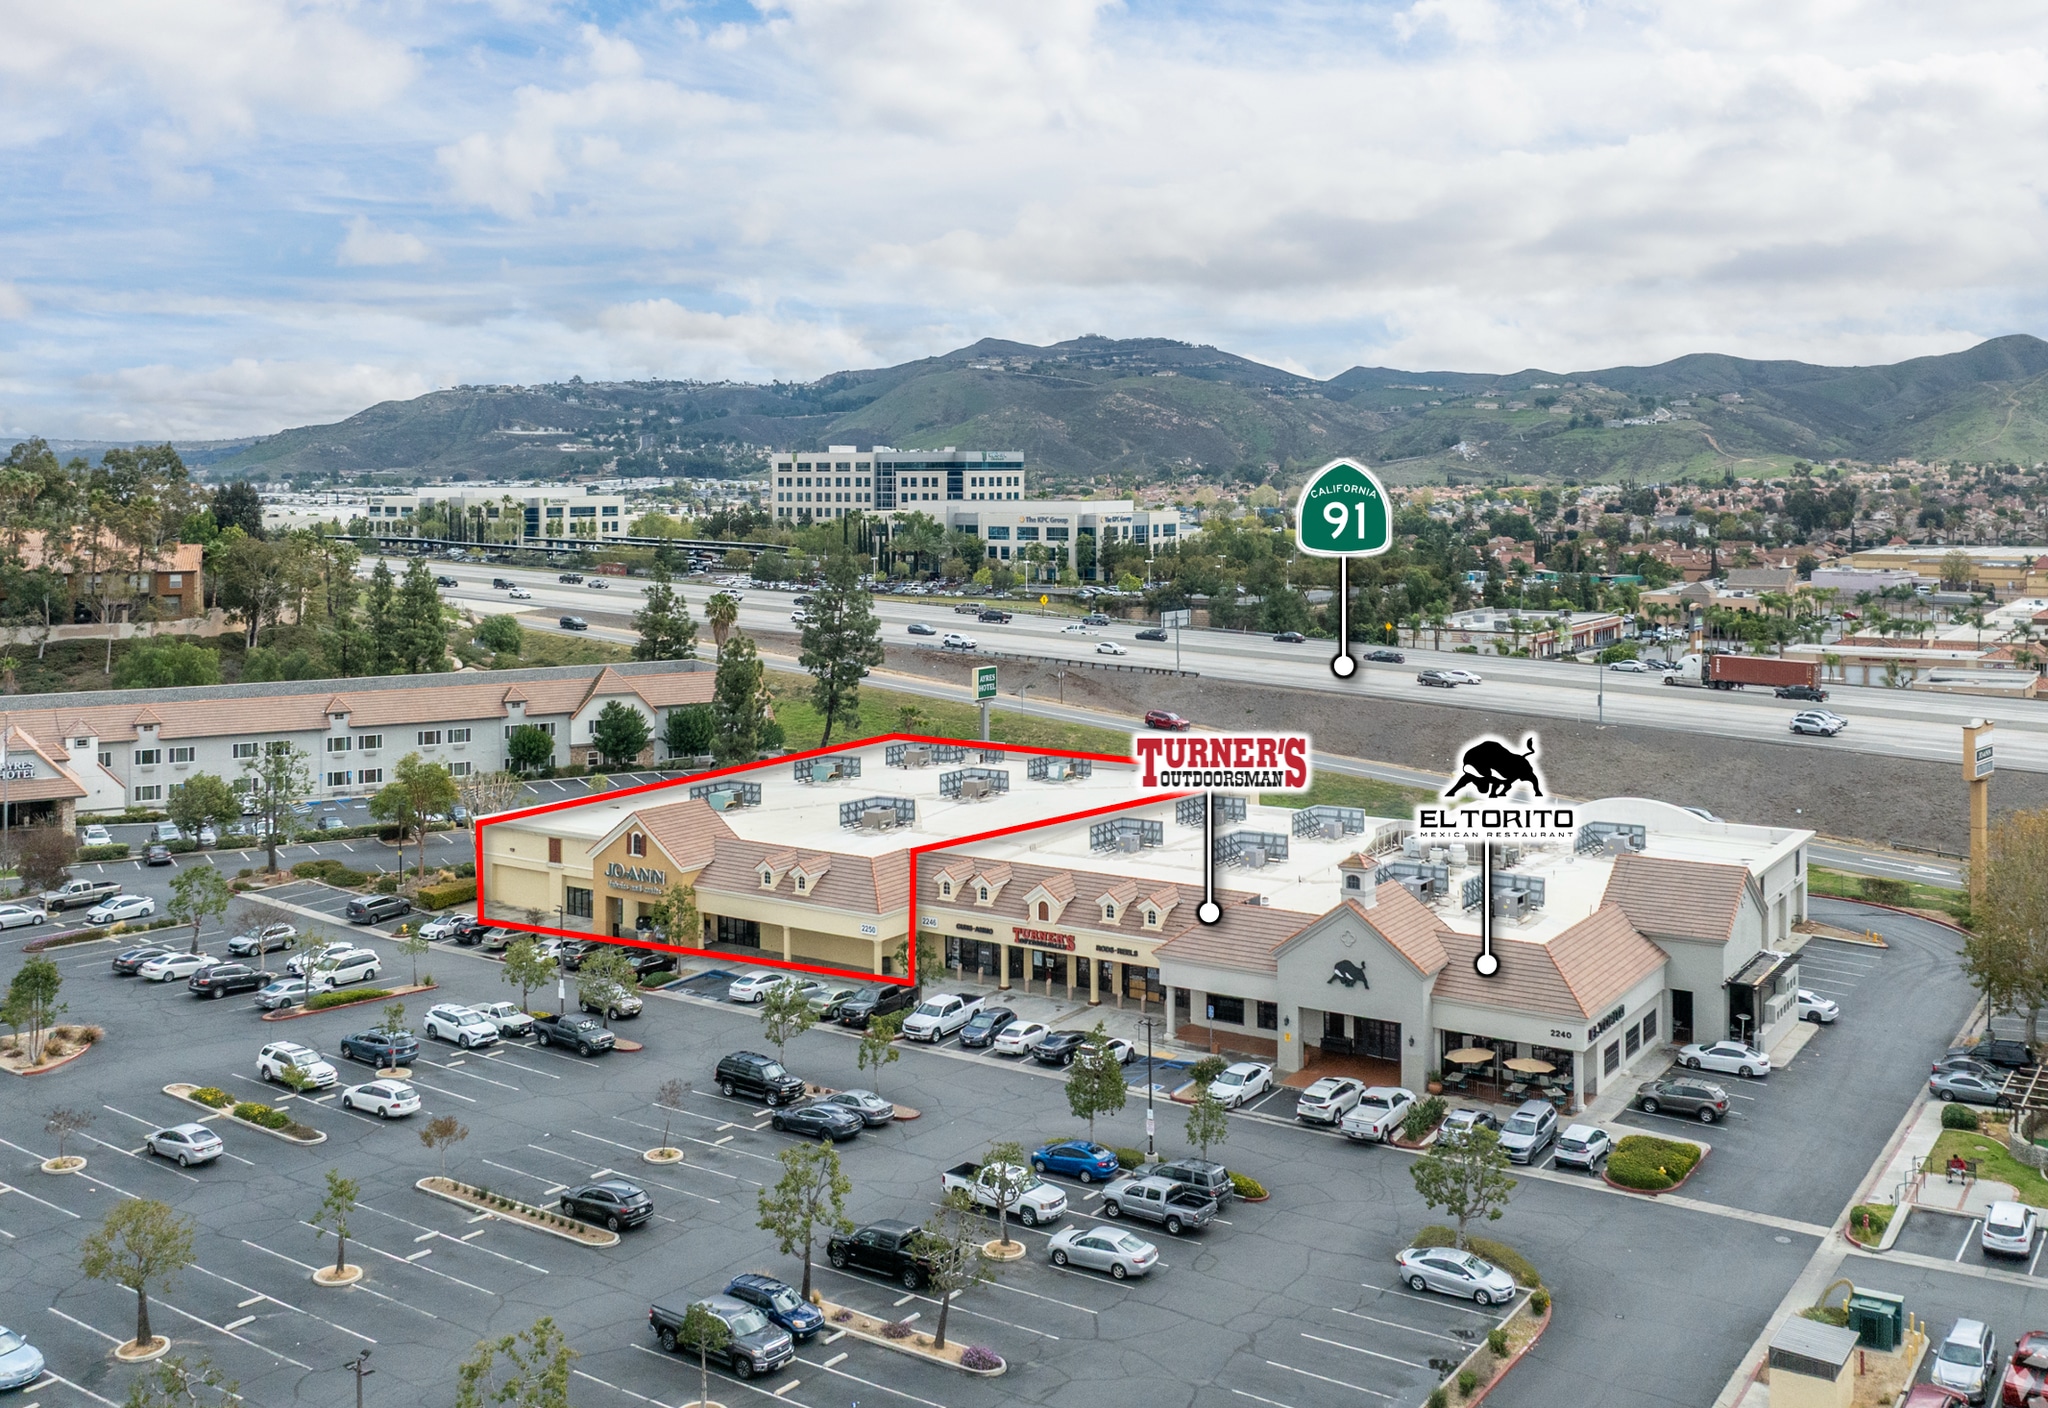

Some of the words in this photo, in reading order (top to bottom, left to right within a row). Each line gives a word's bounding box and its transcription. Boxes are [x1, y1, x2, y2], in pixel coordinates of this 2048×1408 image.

[980, 674, 995, 682] AYRES
[978, 683, 996, 691] HOTEL
[861, 925, 876, 934] 2250
[1012, 927, 1076, 951] TURNER'S
[1550, 1029, 1572, 1039] 2240
